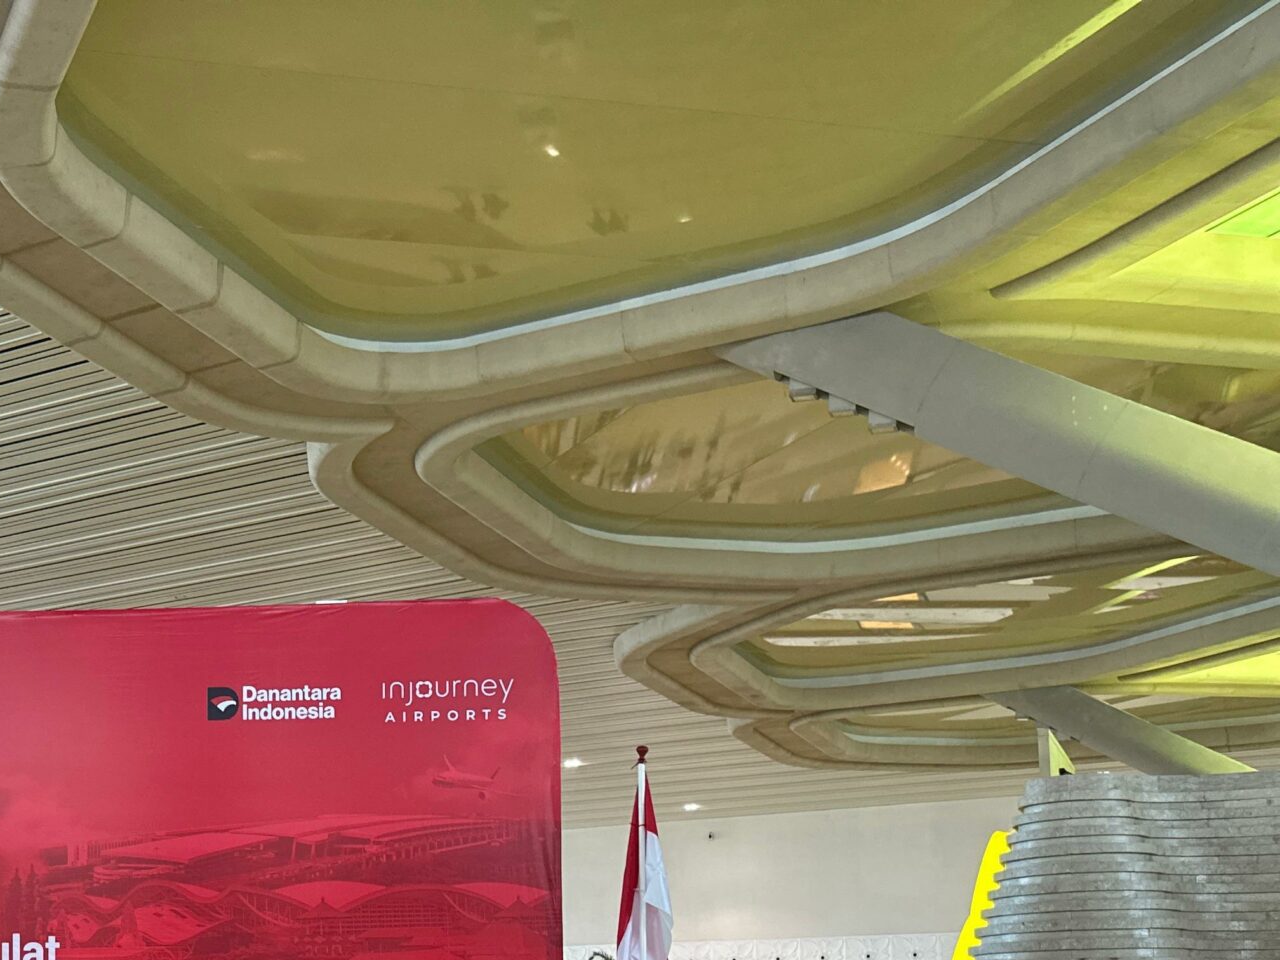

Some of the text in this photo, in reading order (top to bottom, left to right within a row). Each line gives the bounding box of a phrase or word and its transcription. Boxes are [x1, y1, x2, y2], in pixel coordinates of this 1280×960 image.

[242, 685, 342, 702] Danantara
[382, 678, 514, 707] injourney
[242, 703, 336, 721] Indonesia
[384, 708, 508, 723] AIRPORTS
